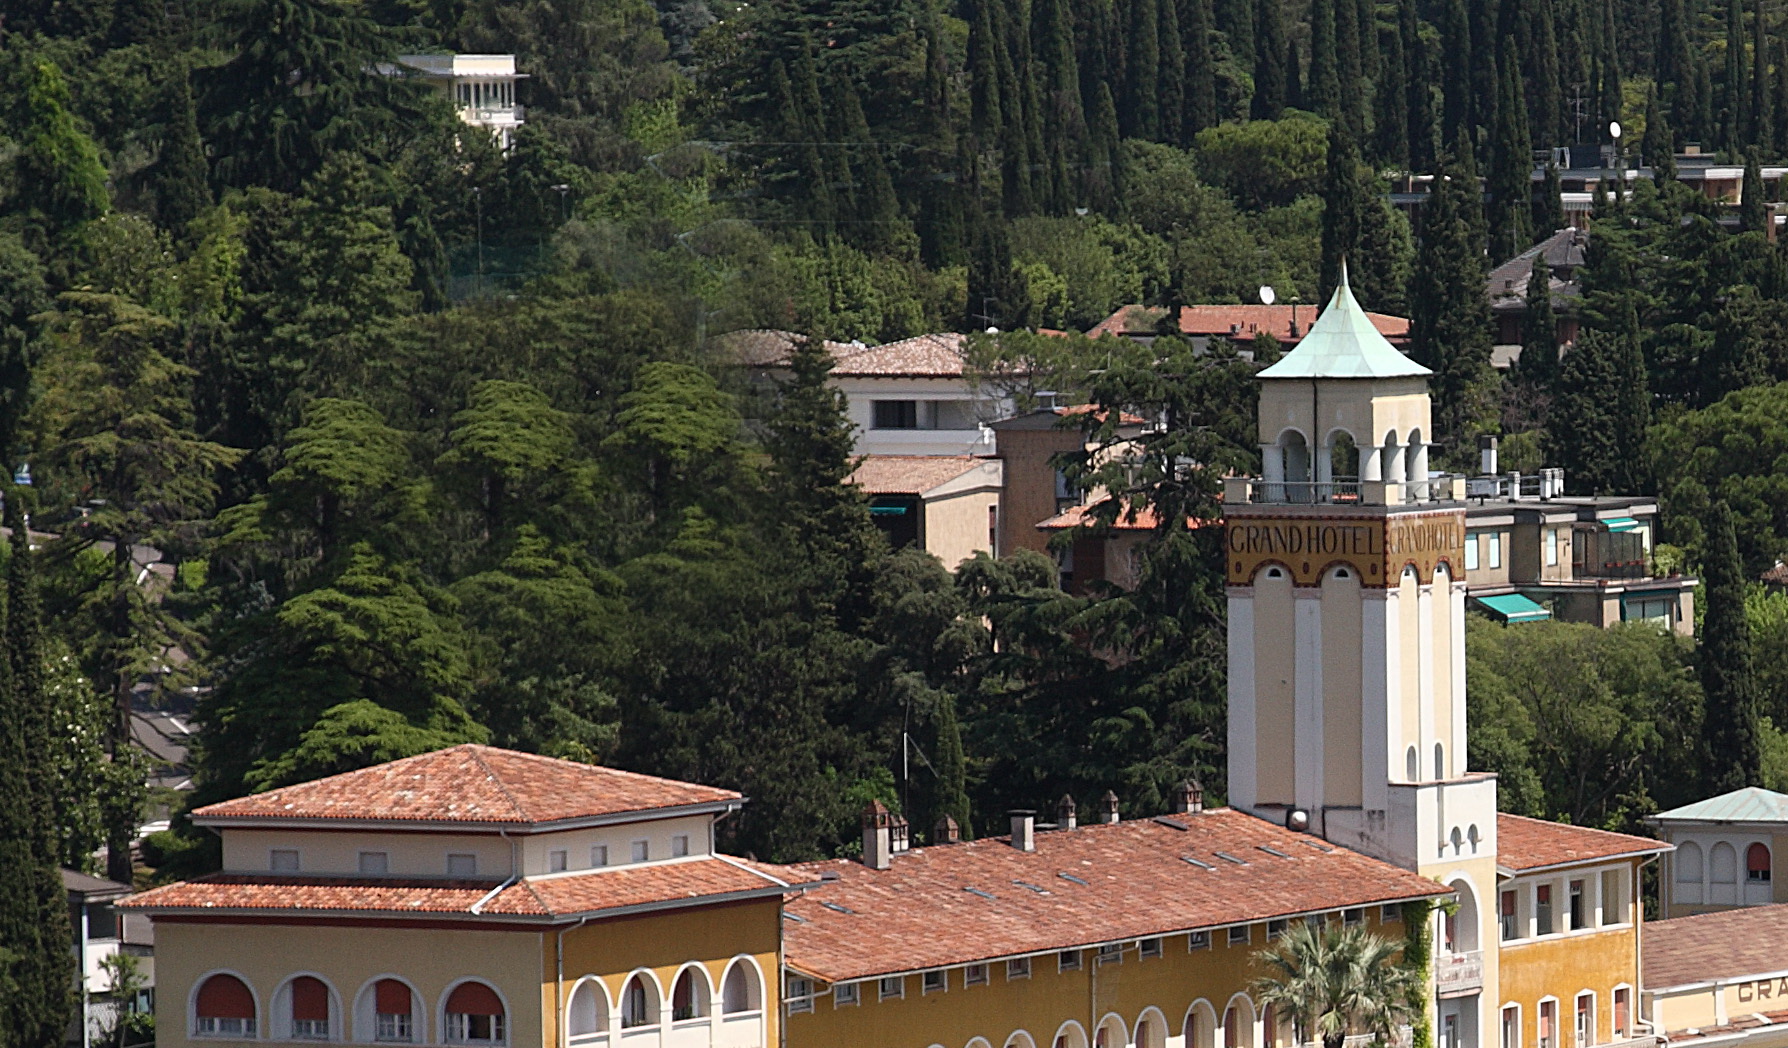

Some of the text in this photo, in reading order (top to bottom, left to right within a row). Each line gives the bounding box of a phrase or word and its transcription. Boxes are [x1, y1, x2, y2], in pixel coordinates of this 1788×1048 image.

[1230, 525, 1382, 555] GRAND HOTEL
[1389, 522, 1463, 554] GRAND HOTEL
